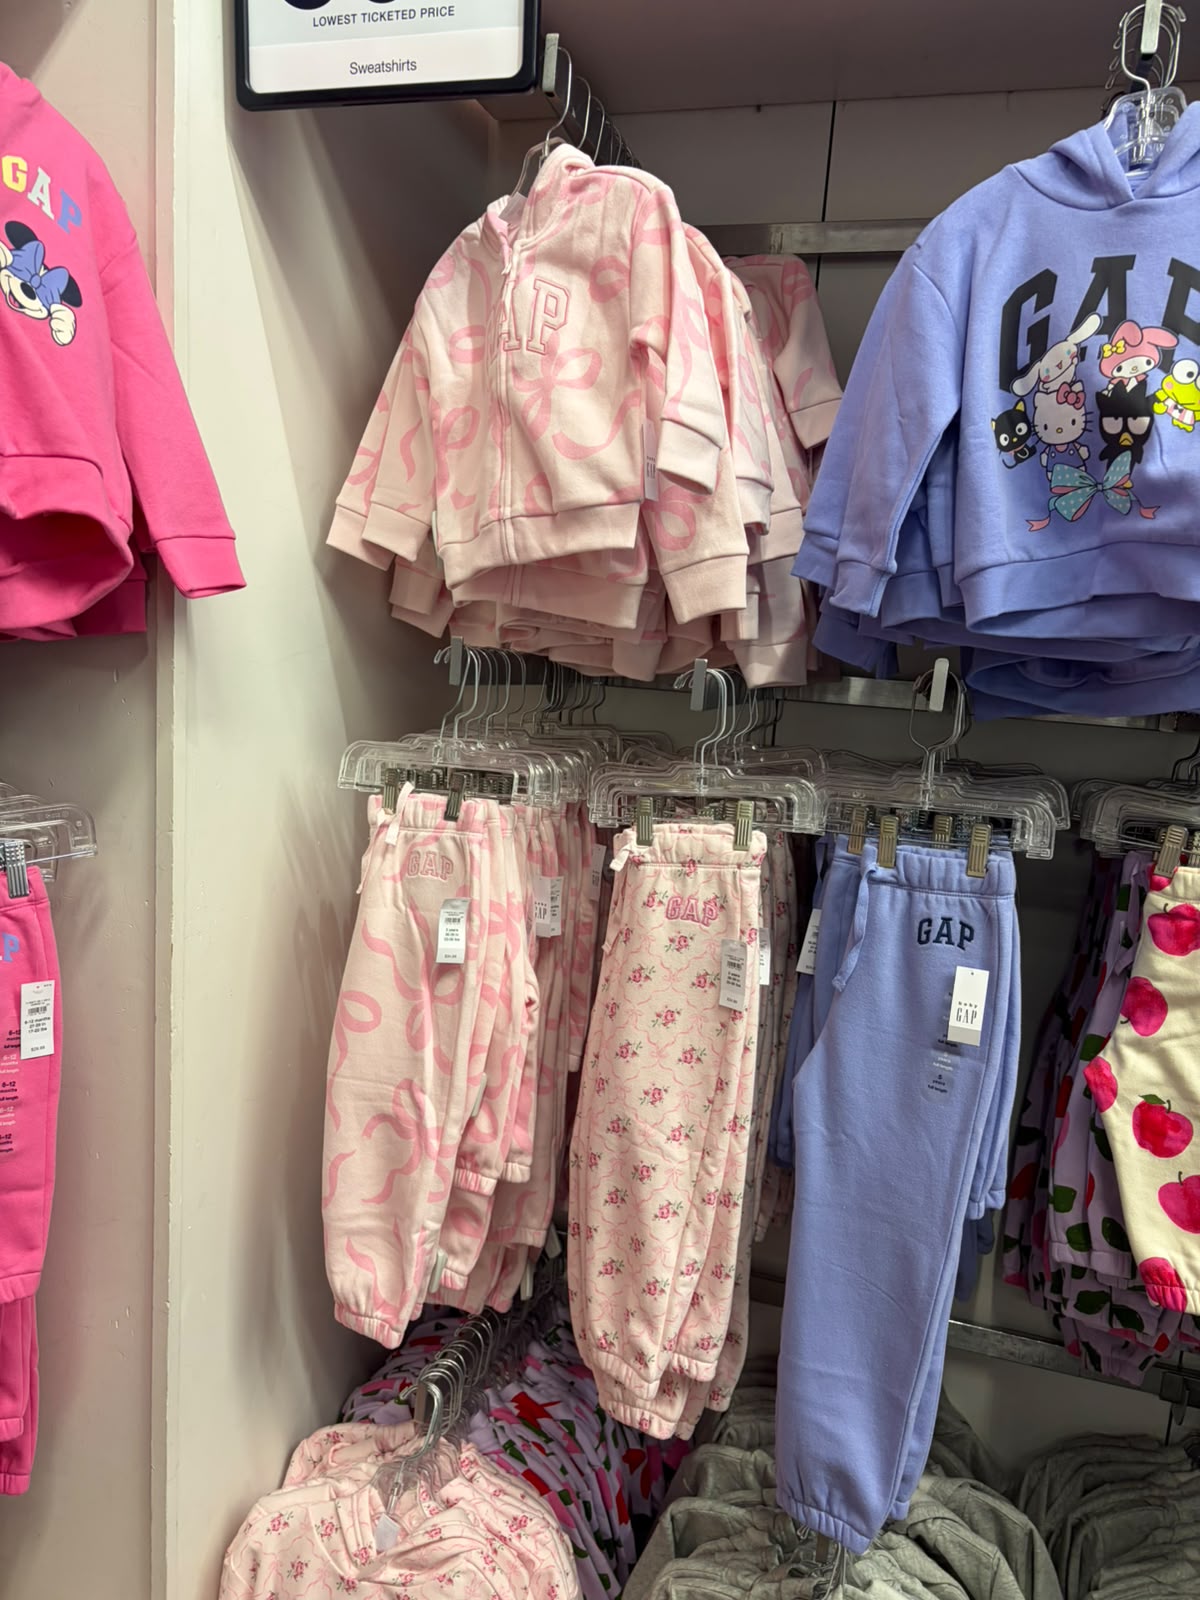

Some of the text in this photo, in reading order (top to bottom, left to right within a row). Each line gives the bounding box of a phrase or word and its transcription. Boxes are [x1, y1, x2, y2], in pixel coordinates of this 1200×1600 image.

[313, 5, 456, 27] LOWEST TICKETED PRICE
[349, 58, 417, 76] Sweatshirts
[1, 155, 83, 235] GAP
[496, 277, 570, 356] AP
[1000, 254, 1200, 393] GAP
[407, 850, 455, 882] GAP
[665, 895, 719, 927] GAP
[917, 917, 975, 951] GAP
[956, 1007, 978, 1025] GAP
